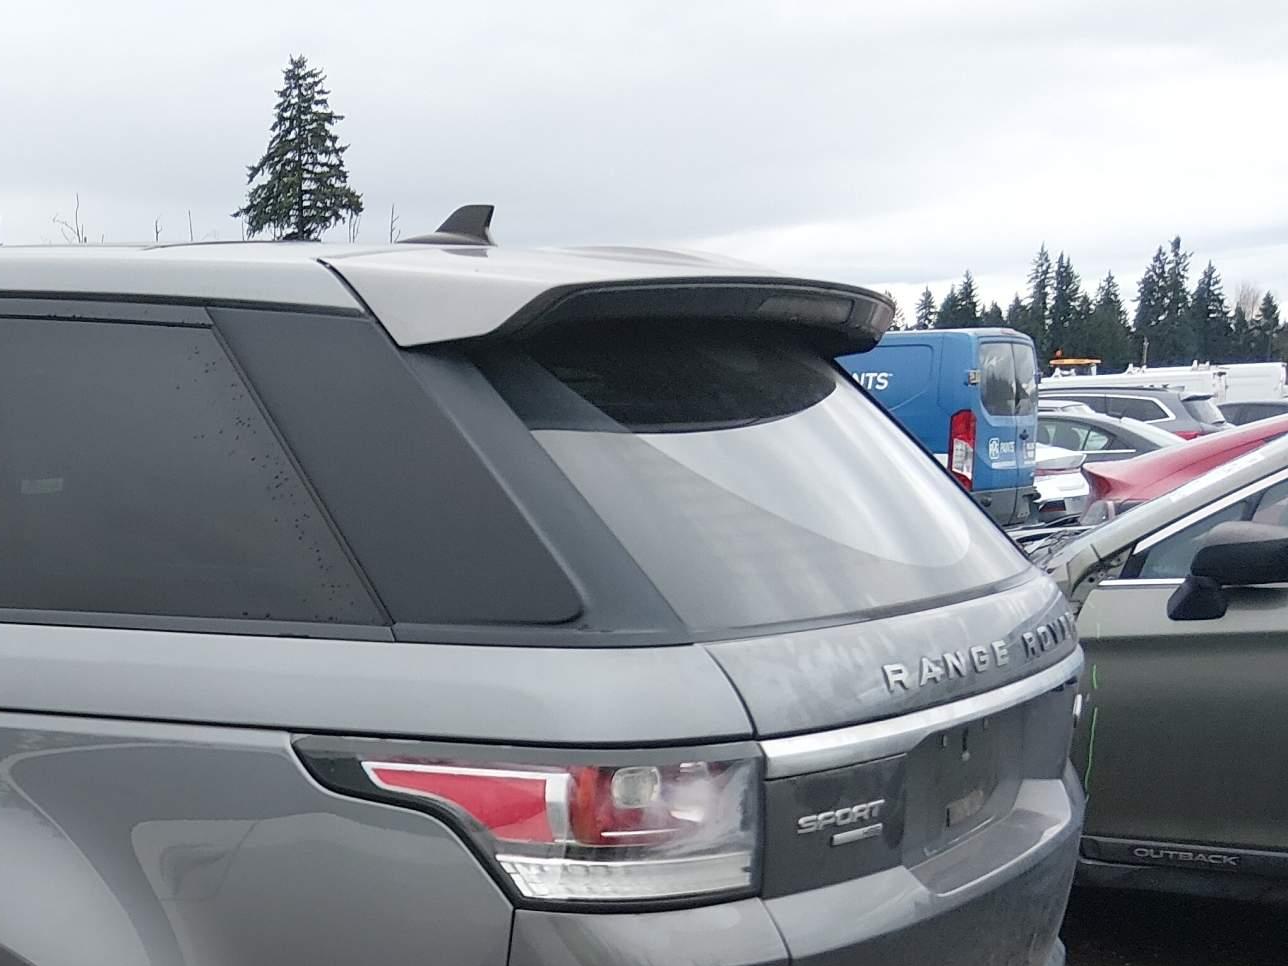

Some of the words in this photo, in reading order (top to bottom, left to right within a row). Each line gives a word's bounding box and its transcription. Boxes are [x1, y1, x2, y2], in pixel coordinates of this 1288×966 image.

[882, 639, 1011, 694] RANGE
[797, 798, 886, 835] SPORT
[1133, 847, 1241, 867] OUTBACK
